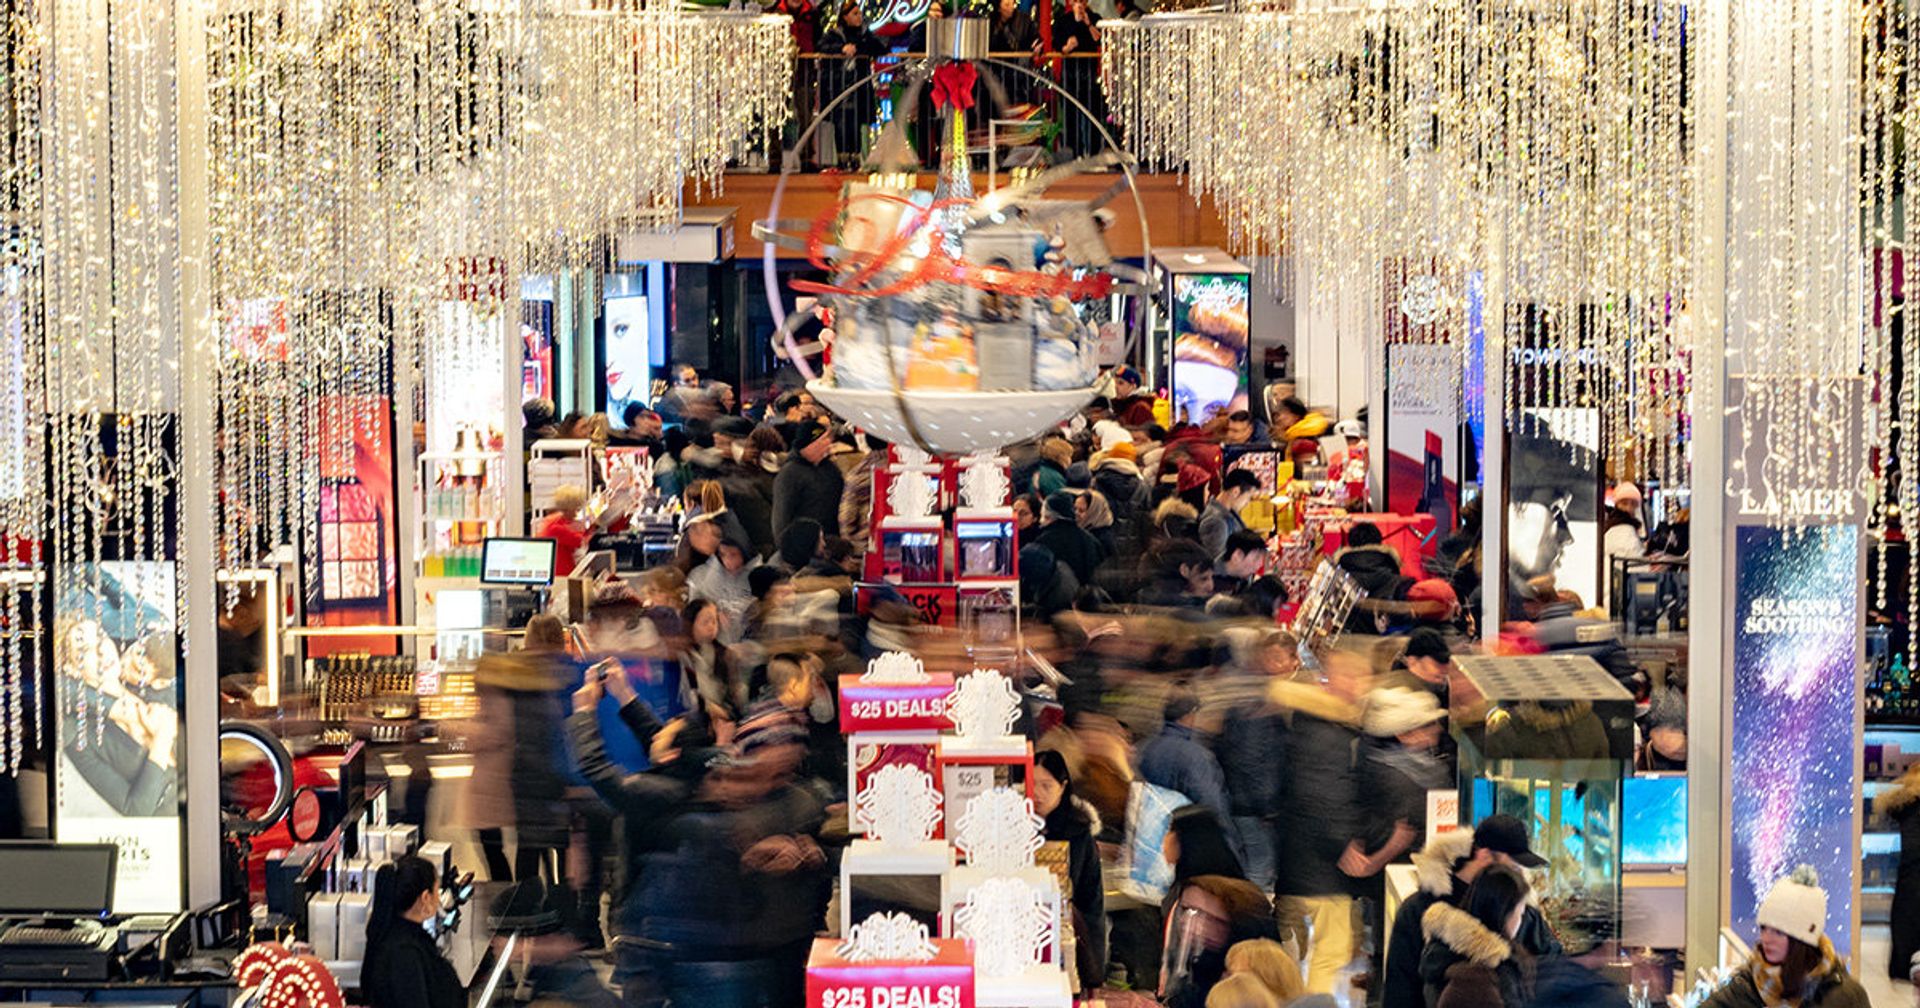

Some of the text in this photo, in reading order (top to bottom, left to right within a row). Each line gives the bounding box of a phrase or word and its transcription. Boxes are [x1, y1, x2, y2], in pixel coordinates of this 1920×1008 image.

[1739, 488, 1855, 515] LA MER
[1744, 615, 1846, 634] SOOTHING
[851, 701, 882, 719] $25
[958, 771, 982, 787] $25
[822, 986, 961, 1008] $25 DEALS!
